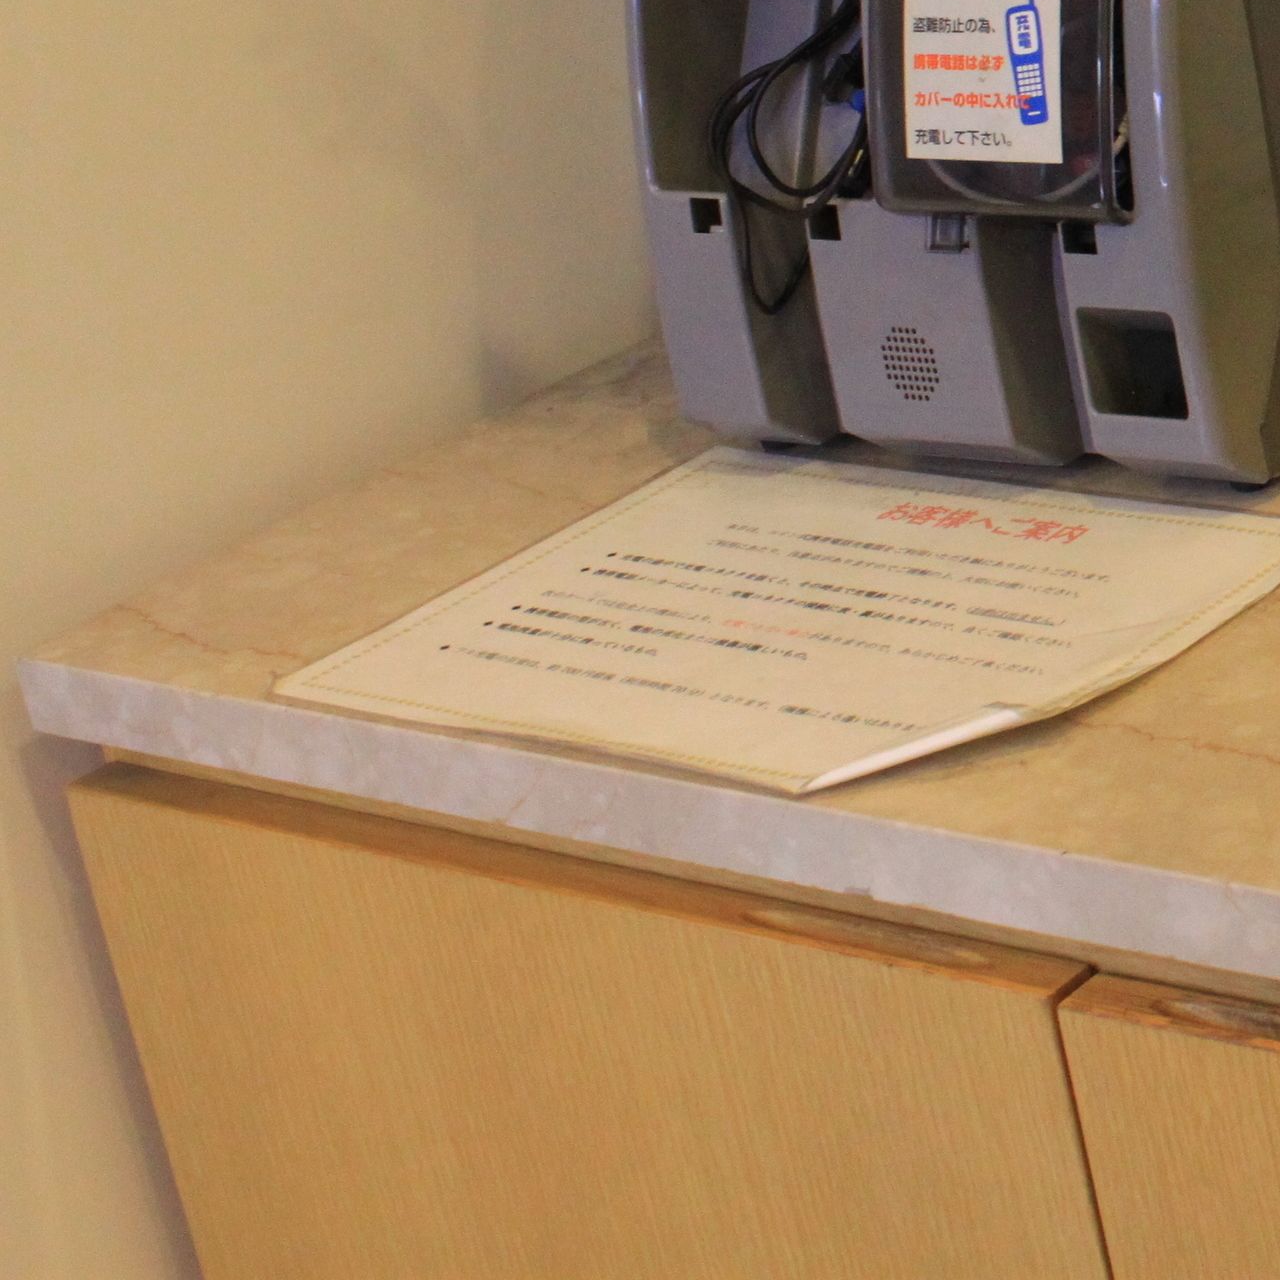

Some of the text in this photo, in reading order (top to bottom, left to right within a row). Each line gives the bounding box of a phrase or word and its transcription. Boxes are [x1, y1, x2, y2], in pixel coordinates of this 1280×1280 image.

[912, 17, 997, 34] 盗難防止の為、
[913, 53, 1005, 72] 携帯電話は必ず
[914, 91, 1031, 109] カバーの中に入れて
[914, 129, 1014, 147] 充電して下さい。
[876, 501, 1090, 546] お客様へご案内
